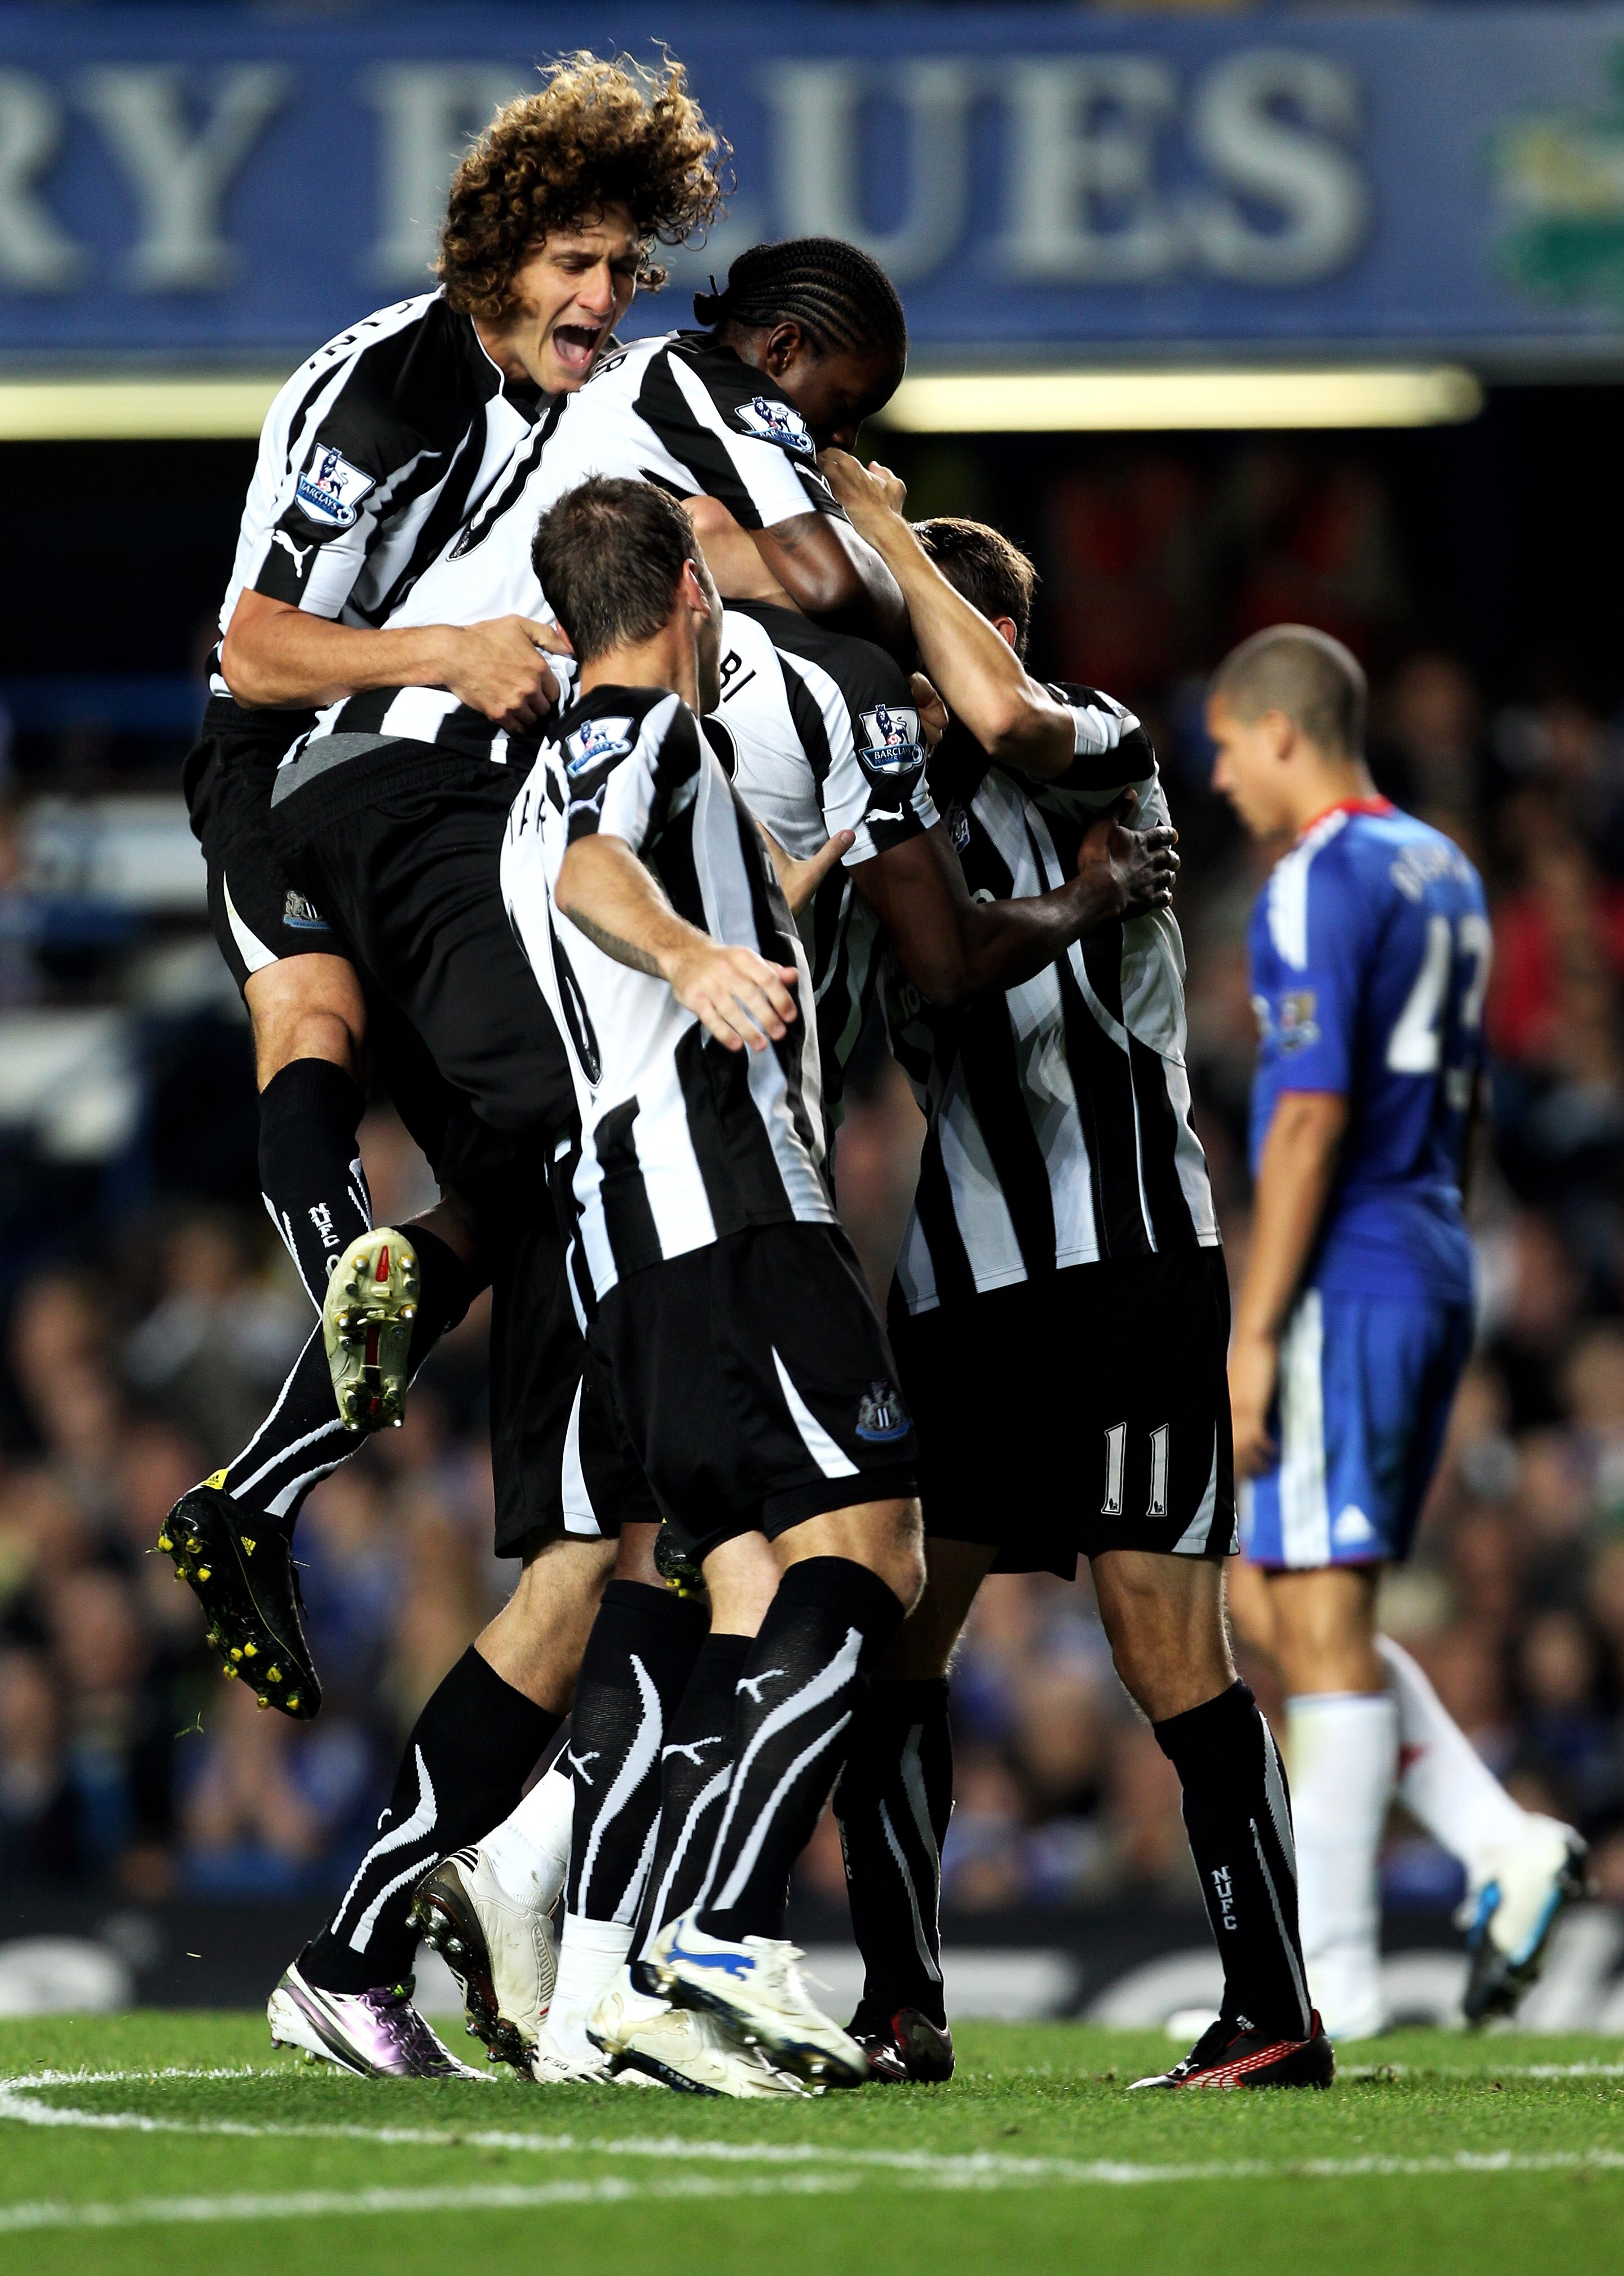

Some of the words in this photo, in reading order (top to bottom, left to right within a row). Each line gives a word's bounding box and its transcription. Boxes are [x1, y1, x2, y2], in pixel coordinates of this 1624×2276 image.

[369, 48, 1371, 289] UES
[874, 747, 911, 760] BARCLAYS
[308, 1202, 341, 1248] NUFC
[1100, 1422, 1169, 1518] 11
[1211, 1865, 1238, 1930] NUFC
[542, 2056, 570, 2071] F50
